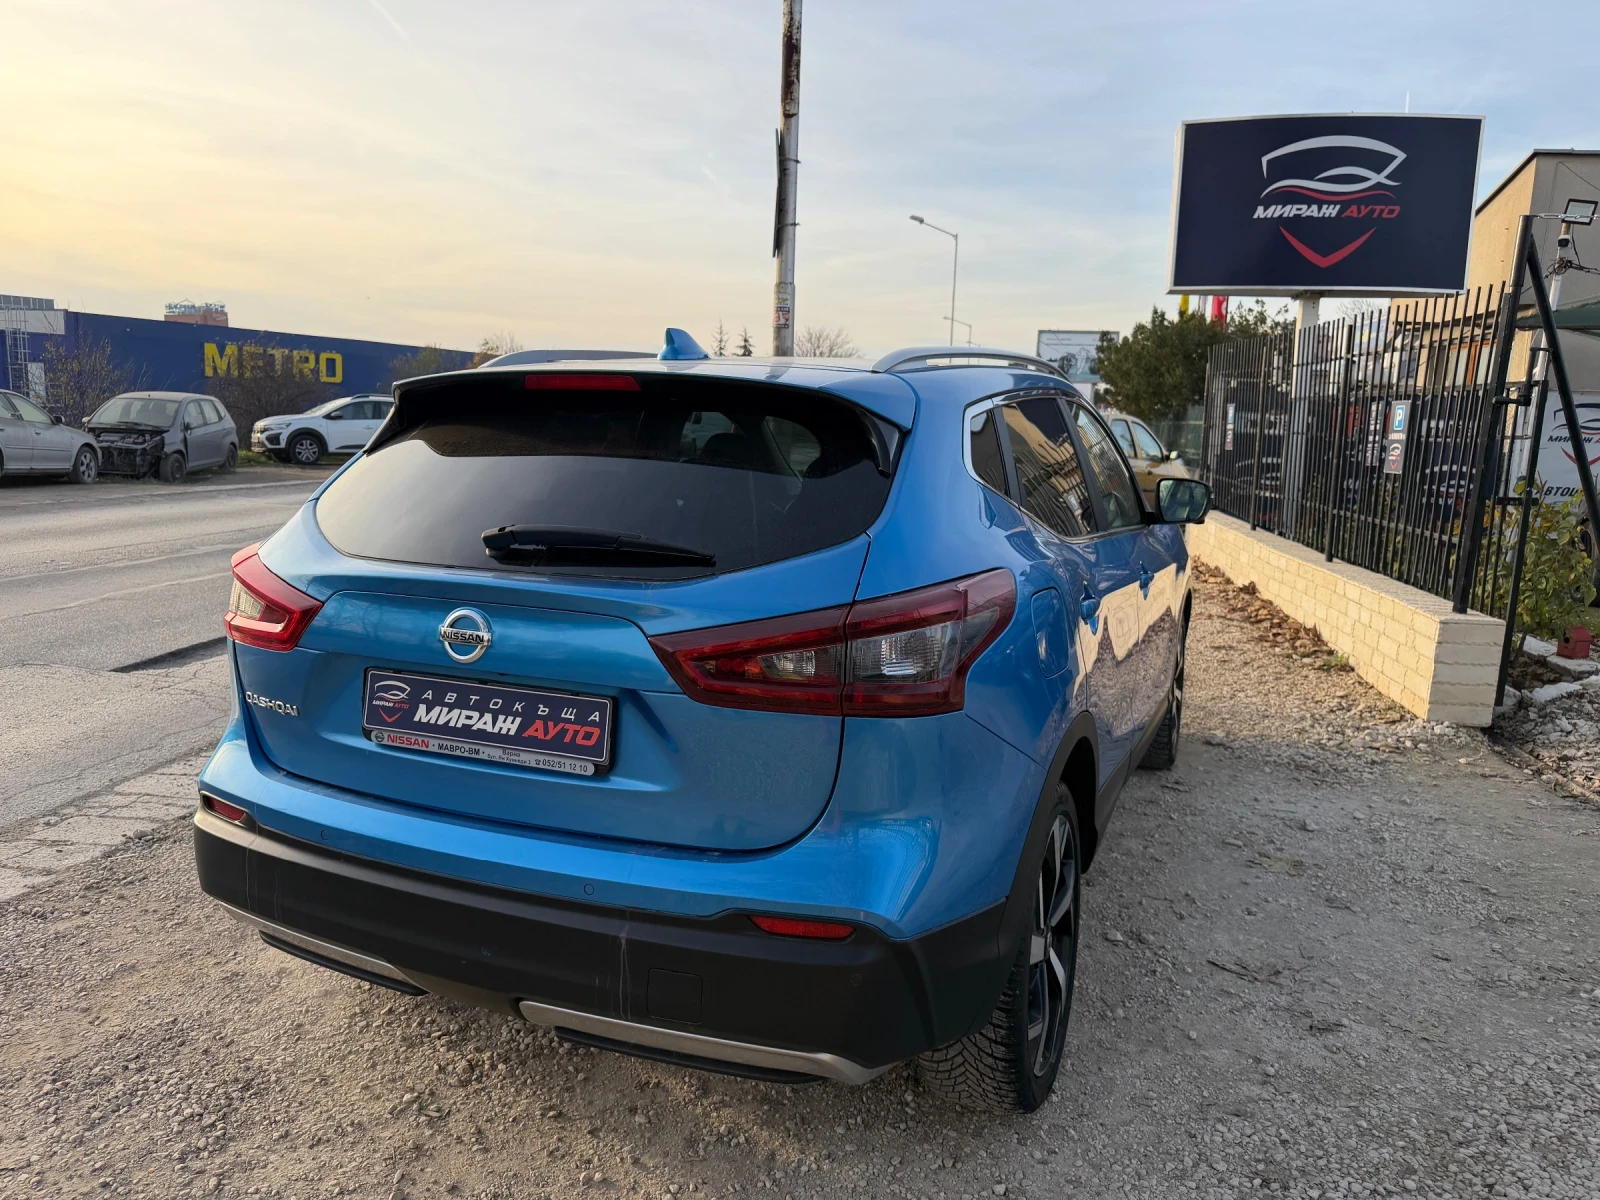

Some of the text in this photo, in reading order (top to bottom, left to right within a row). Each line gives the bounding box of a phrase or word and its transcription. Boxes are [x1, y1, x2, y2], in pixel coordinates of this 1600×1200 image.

[1252, 204, 1401, 219] МИРАЖ АУТО
[203, 342, 343, 384] METRO
[1547, 435, 1594, 444] МИЖ
[441, 630, 485, 643] NISSAN
[245, 691, 299, 717] QASHQAI
[421, 689, 600, 723] АВТОКЪЩА
[413, 704, 601, 747] МИРАЖ АУТО
[386, 733, 481, 757] NISSAN МАВРО-ВМ
[502, 748, 521, 758] Варна
[542, 758, 588, 773] 052/51 12 10
